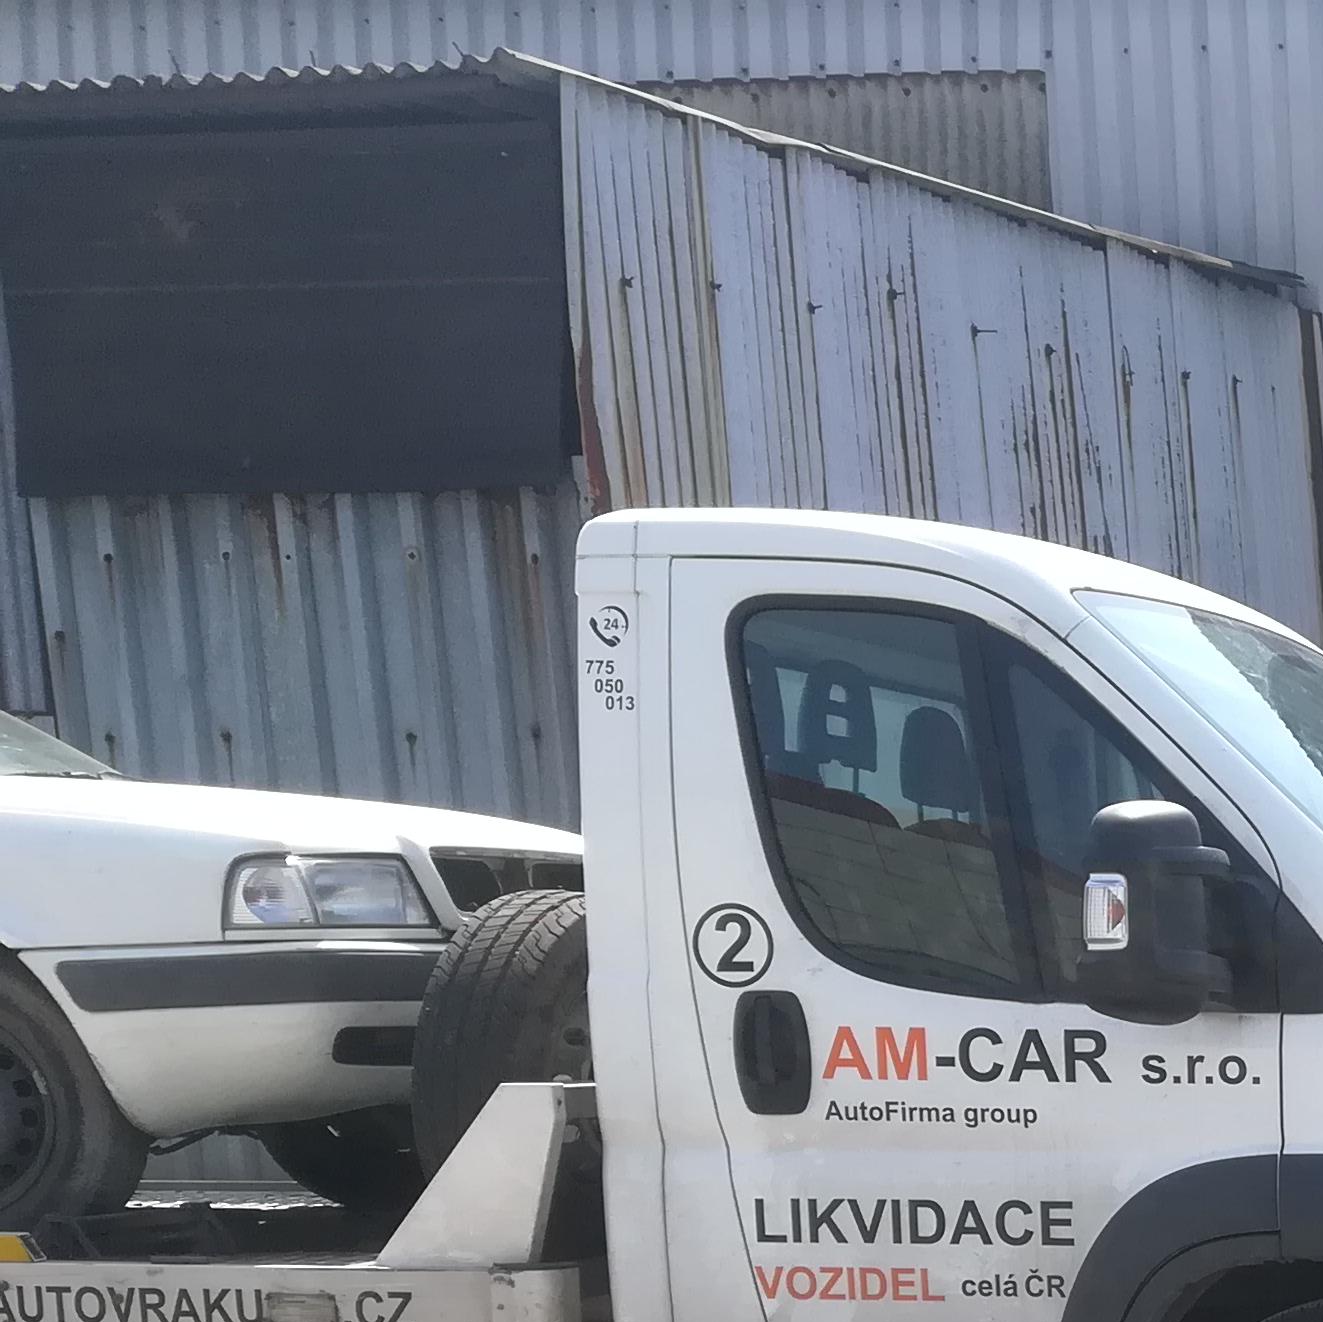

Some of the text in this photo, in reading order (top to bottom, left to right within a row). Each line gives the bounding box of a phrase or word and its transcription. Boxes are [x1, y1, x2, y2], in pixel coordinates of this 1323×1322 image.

[603, 618, 619, 630] 24
[585, 660, 615, 675] 775
[594, 678, 624, 693] 050
[605, 695, 635, 710] 013
[716, 912, 755, 973] 2
[822, 1025, 1261, 1085] AM-CAR s.r.o.
[824, 1100, 1038, 1129] AutoFirma group
[754, 1197, 1076, 1247] LIKVIDACE
[754, 1266, 1067, 1302] VOZIDEL celá ČR
